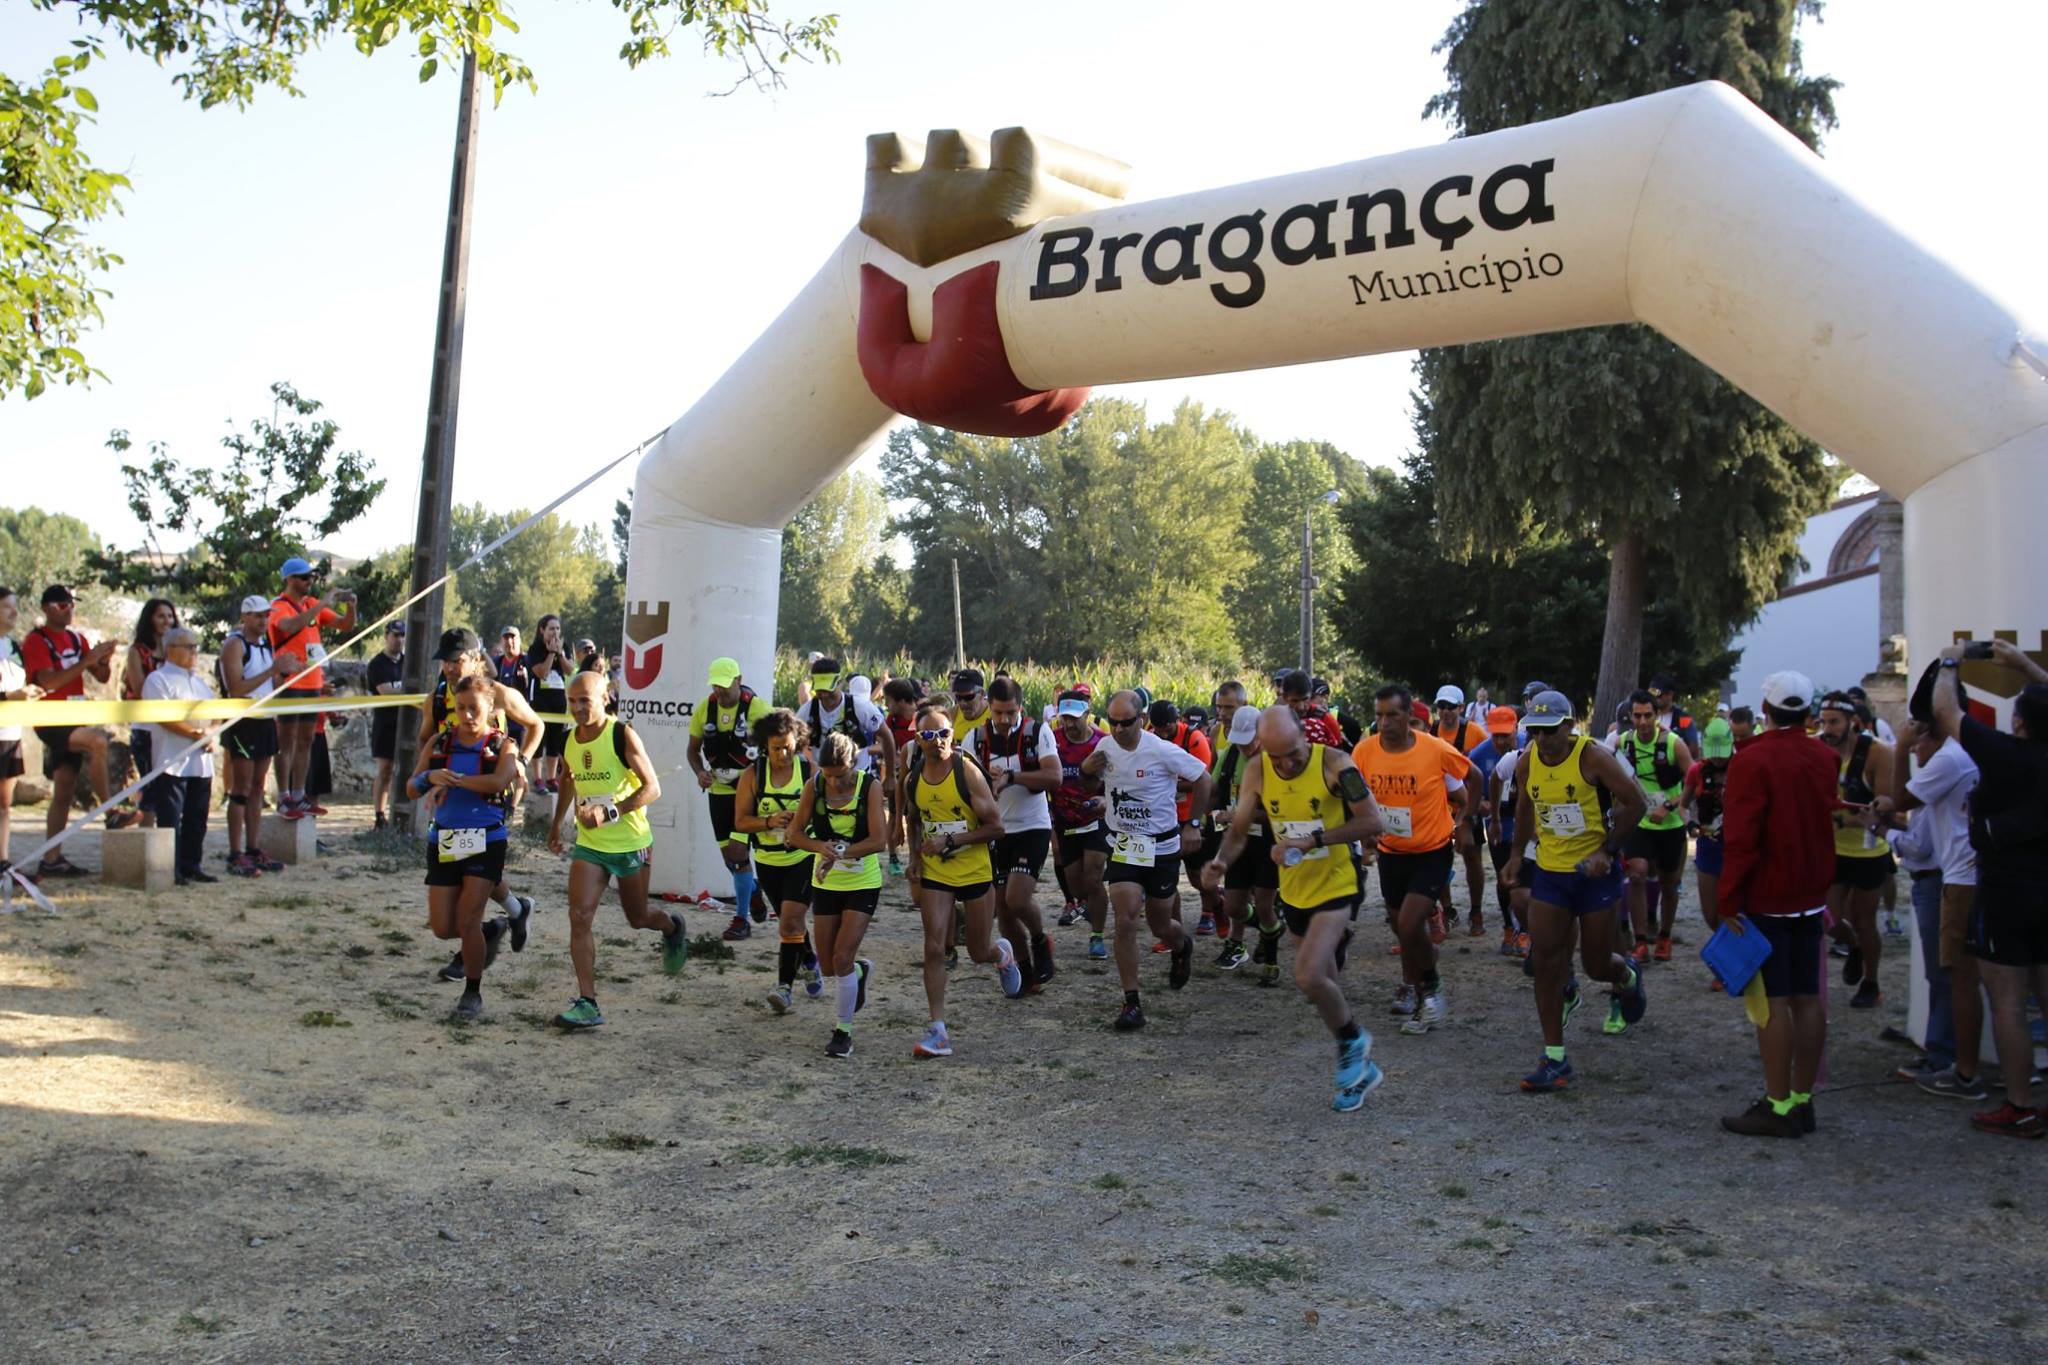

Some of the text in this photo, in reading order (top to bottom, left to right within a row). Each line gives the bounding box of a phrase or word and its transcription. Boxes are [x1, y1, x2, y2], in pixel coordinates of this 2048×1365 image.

[1029, 157, 1556, 309] Bragança
[1347, 246, 1565, 306] Município
[618, 699, 693, 720] agança
[1387, 815, 1400, 825] 76
[1555, 814, 1571, 824] 31
[459, 838, 474, 849] 85
[1132, 842, 1145, 853] 70
